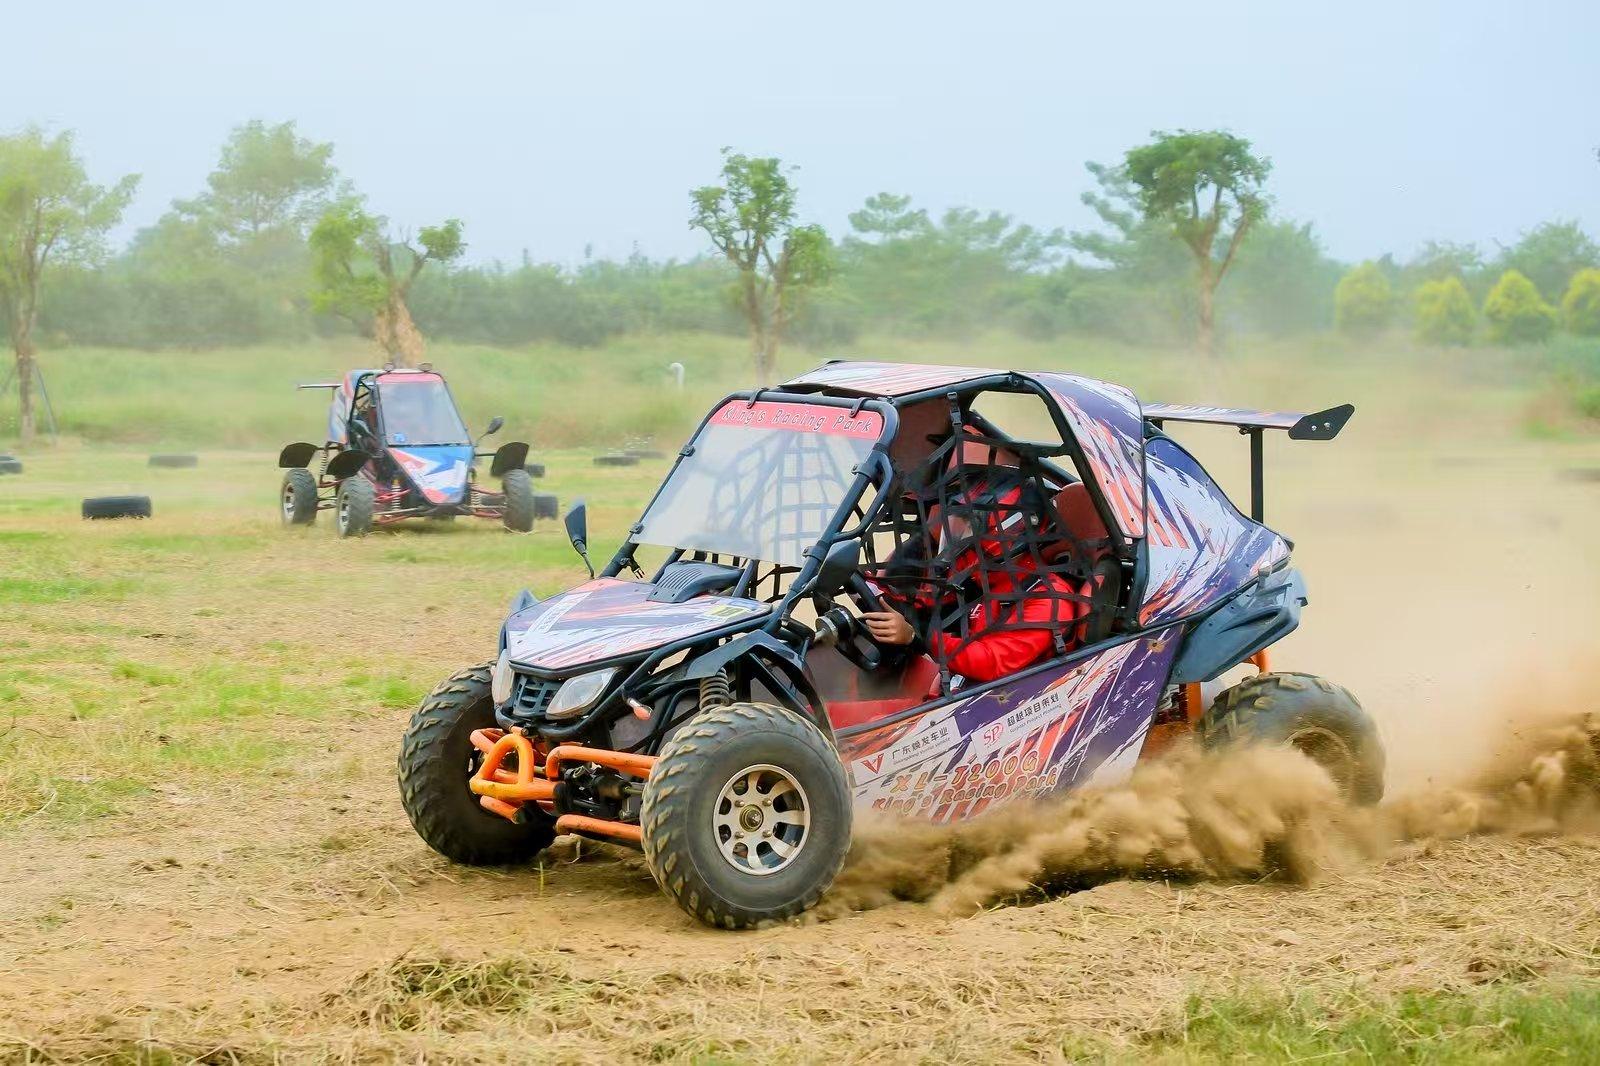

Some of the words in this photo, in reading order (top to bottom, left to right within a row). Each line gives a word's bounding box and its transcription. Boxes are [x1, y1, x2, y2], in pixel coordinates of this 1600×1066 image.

[722, 406, 766, 424] King's
[772, 409, 826, 432] Racing
[832, 415, 873, 432] Park
